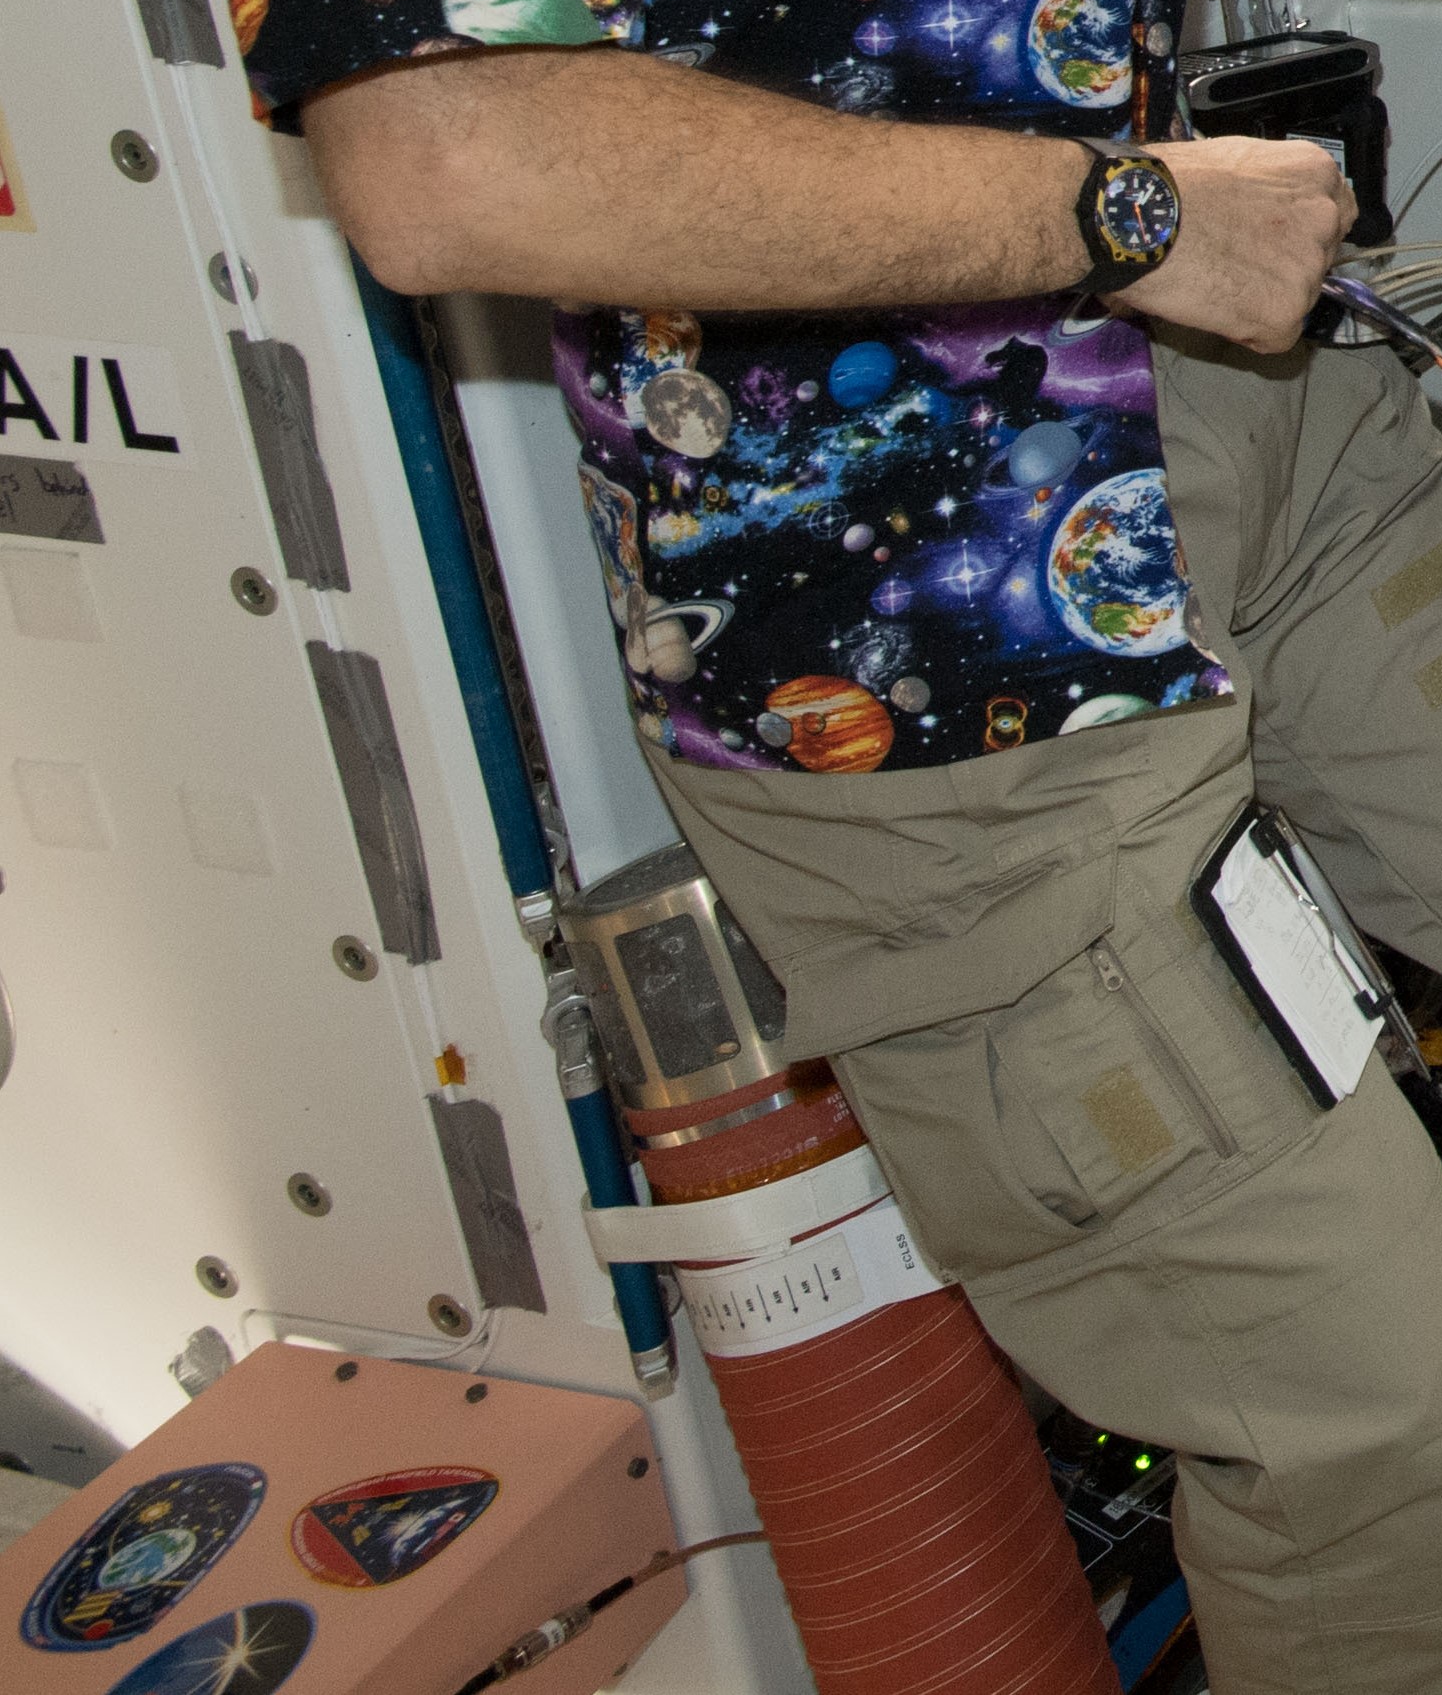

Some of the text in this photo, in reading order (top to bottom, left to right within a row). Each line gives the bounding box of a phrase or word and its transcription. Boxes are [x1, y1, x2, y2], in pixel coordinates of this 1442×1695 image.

[896, 1233, 915, 1270] ECLSS
[831, 1266, 842, 1282] AIR
[800, 1279, 812, 1294] AIR
[772, 1290, 783, 1304] AIR
